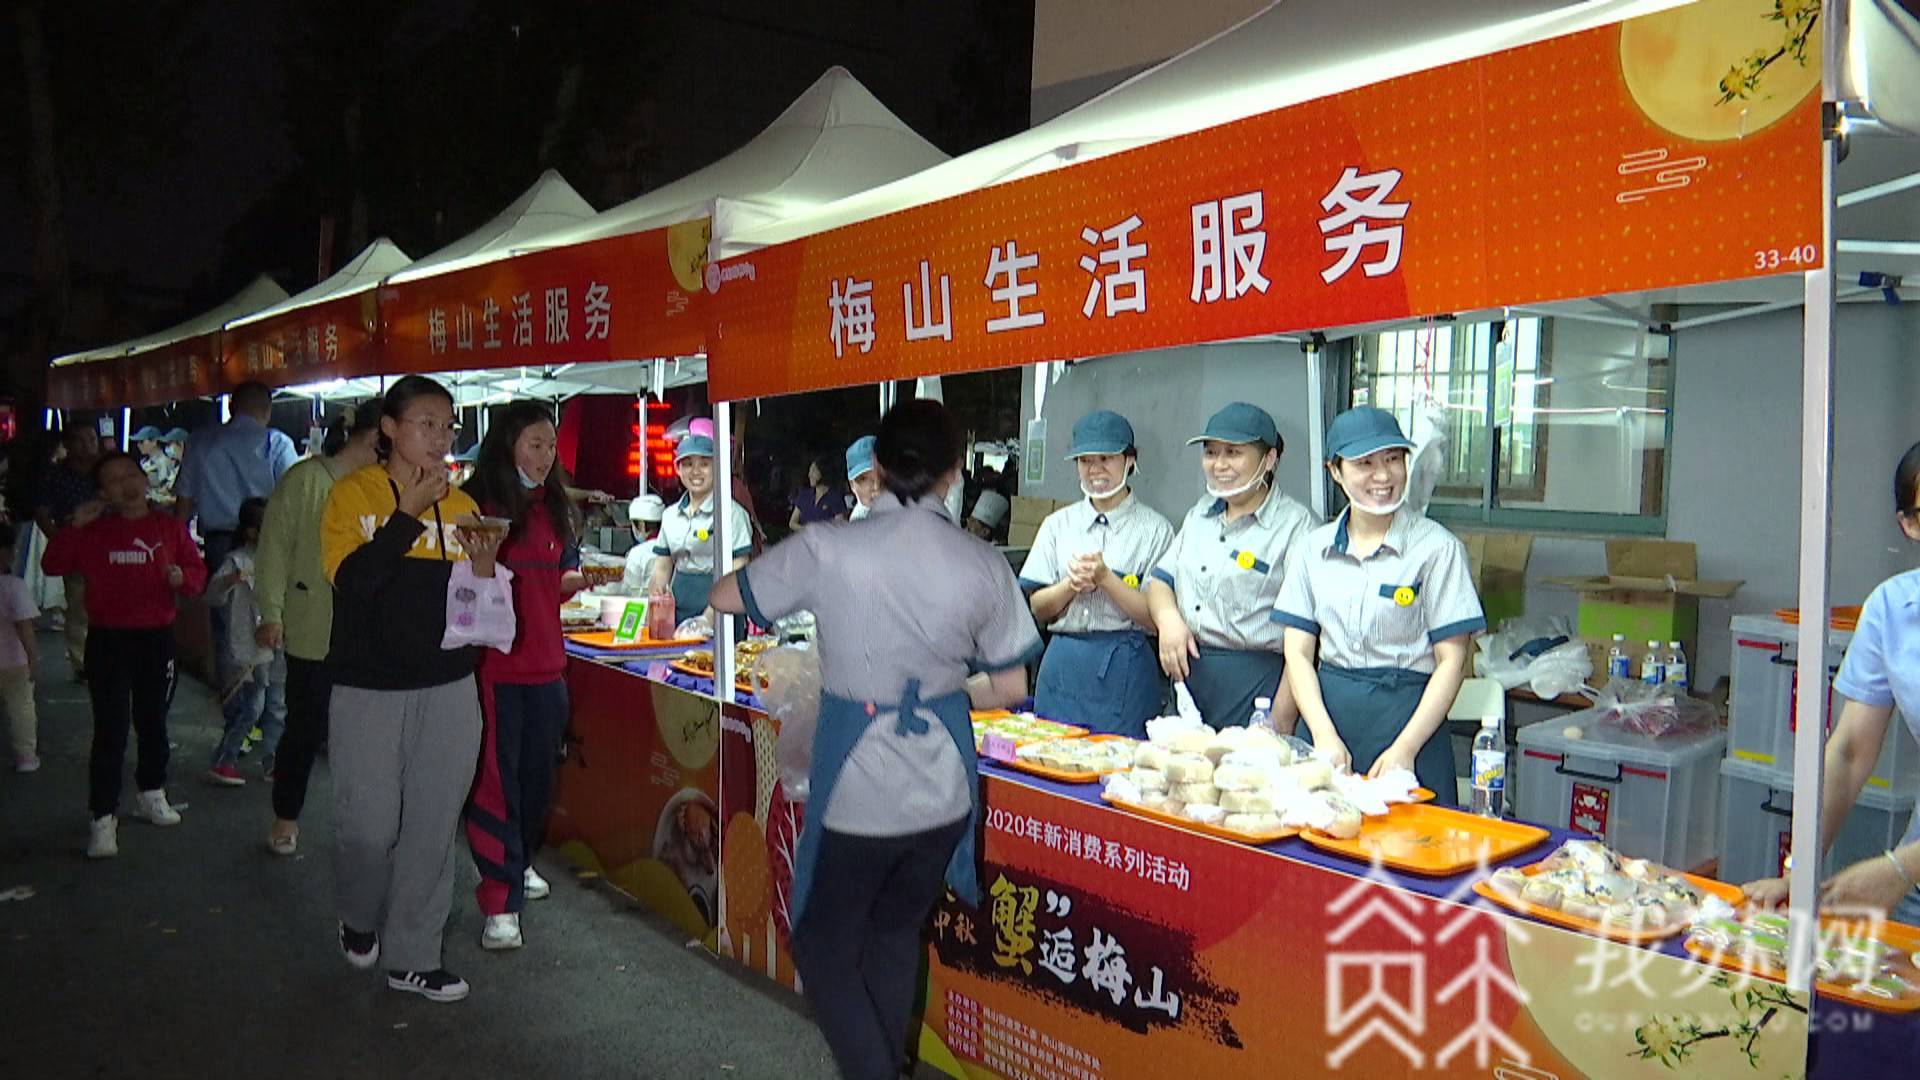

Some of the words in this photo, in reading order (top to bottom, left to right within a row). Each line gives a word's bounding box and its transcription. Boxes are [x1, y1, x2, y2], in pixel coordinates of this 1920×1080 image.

[827, 166, 1412, 358] 梅山生活服务
[1754, 244, 1816, 270] 33-40
[248, 322, 338, 374] 山生服务
[427, 281, 611, 355] 梅山生活服务
[985, 806, 1191, 893] 2020年新消费系列活动
[933, 909, 978, 946] 中秋
